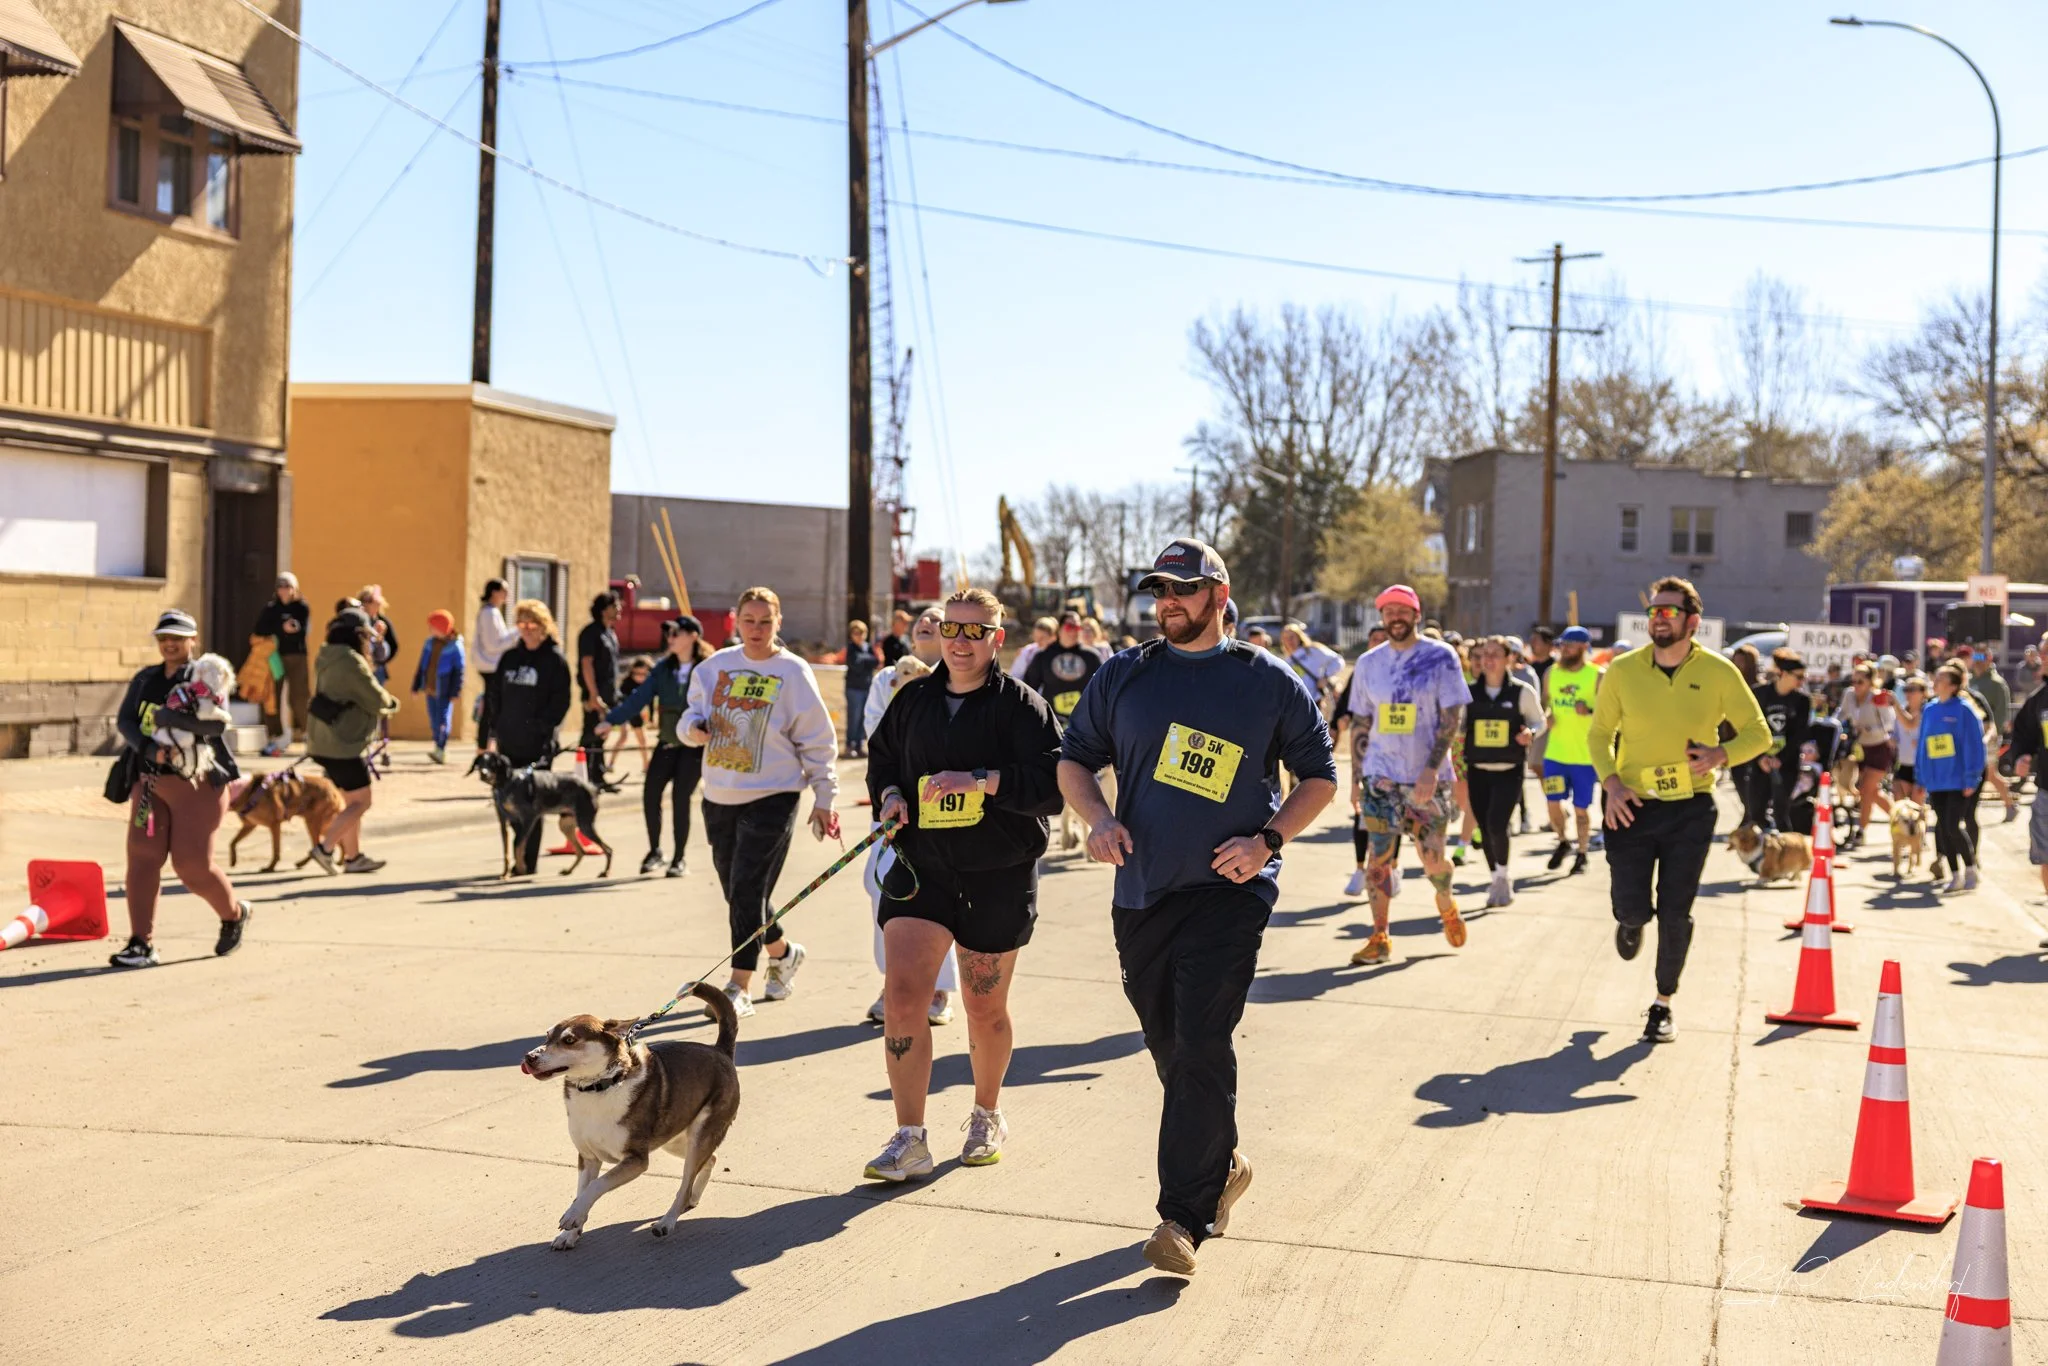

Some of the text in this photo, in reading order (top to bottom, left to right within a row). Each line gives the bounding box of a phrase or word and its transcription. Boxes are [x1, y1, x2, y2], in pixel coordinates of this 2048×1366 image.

[1803, 630, 1853, 648] ROAD
[744, 686, 765, 697] 136
[1208, 741, 1224, 755] 5K
[1180, 751, 1215, 778] 198
[1656, 777, 1678, 791] 158
[939, 793, 966, 812] 197
